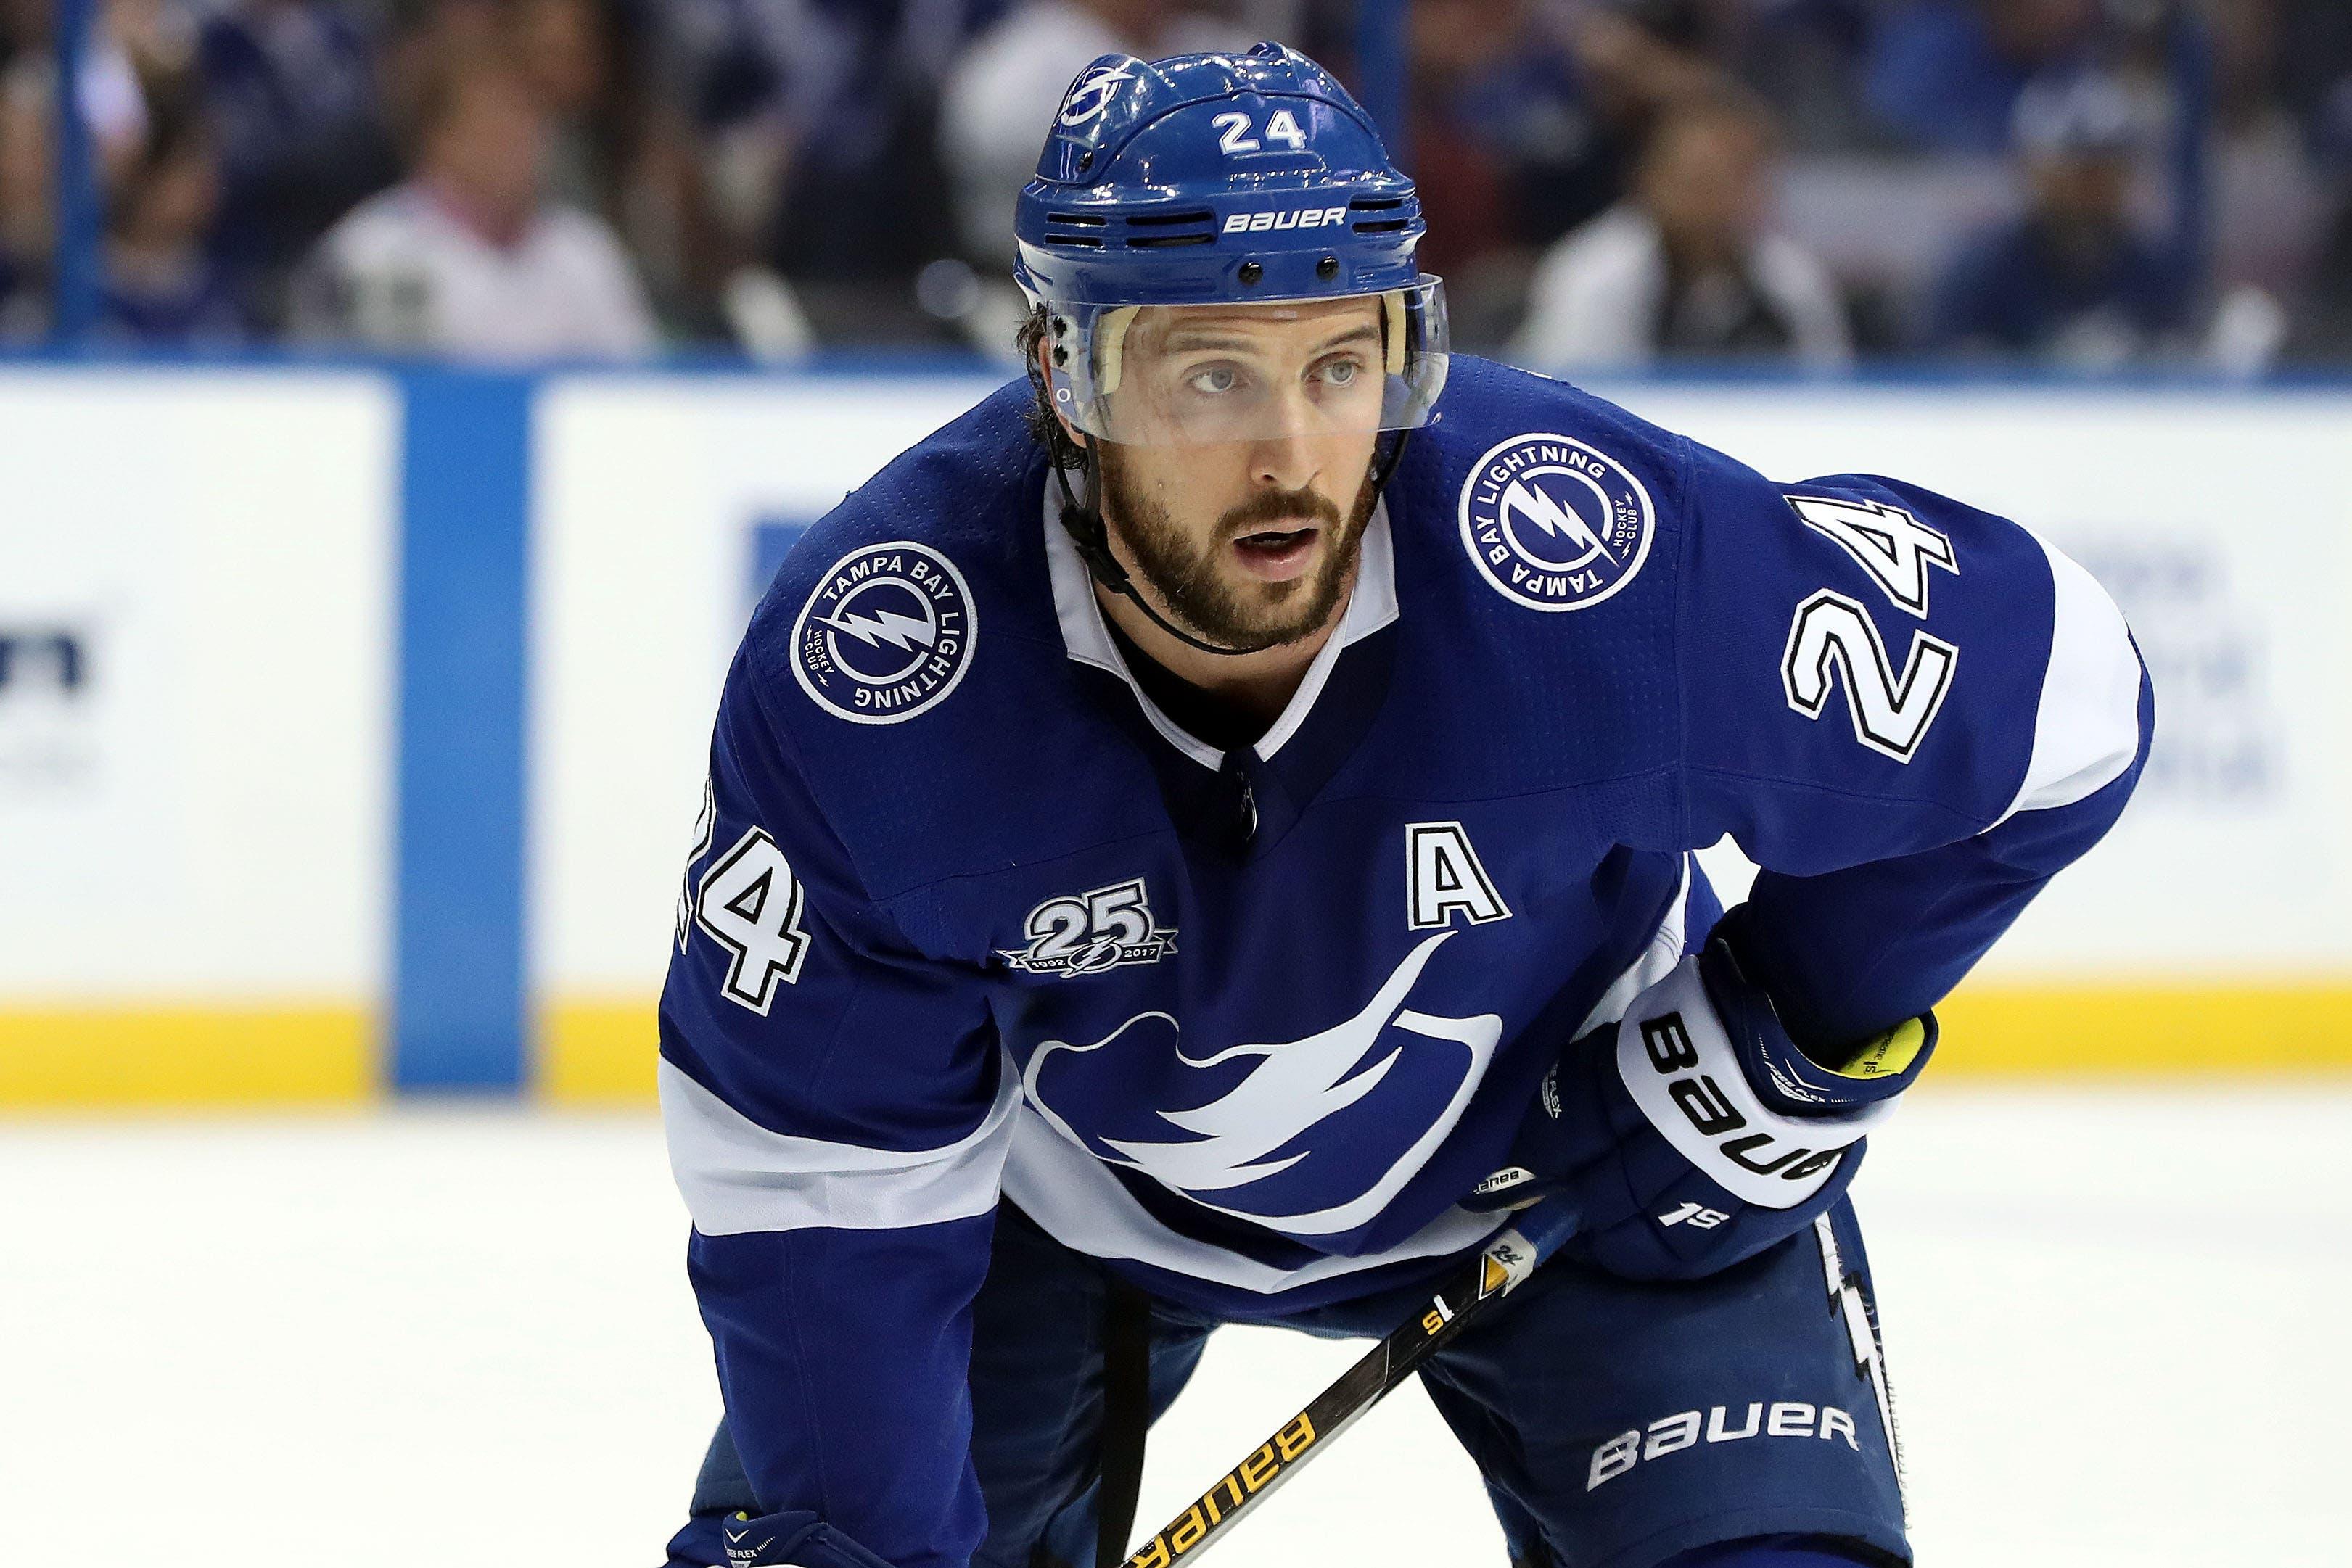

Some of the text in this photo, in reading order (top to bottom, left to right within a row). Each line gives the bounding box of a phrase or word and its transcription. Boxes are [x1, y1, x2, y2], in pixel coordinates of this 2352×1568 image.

[1212, 110, 1309, 154] 24
[1222, 207, 1346, 234] BAUER
[1476, 445, 1606, 596] TAMPA BAY LIGHTNING
[1613, 500, 1625, 547] HOCKEY
[1626, 508, 1638, 539] CLUB
[813, 630, 834, 674] HOCKEY
[823, 556, 960, 709] TAMPA BAY LIGHTNING
[1780, 495, 1960, 765] 24
[805, 643, 819, 671] CLUB
[1405, 820, 1513, 931] A
[1024, 877, 1155, 960] 25
[1124, 947, 1156, 958] 2017
[1422, 1295, 1454, 1335] 1S
[1587, 1403, 1859, 1492] BAUER
[1131, 1411, 1316, 1568] BAUER
